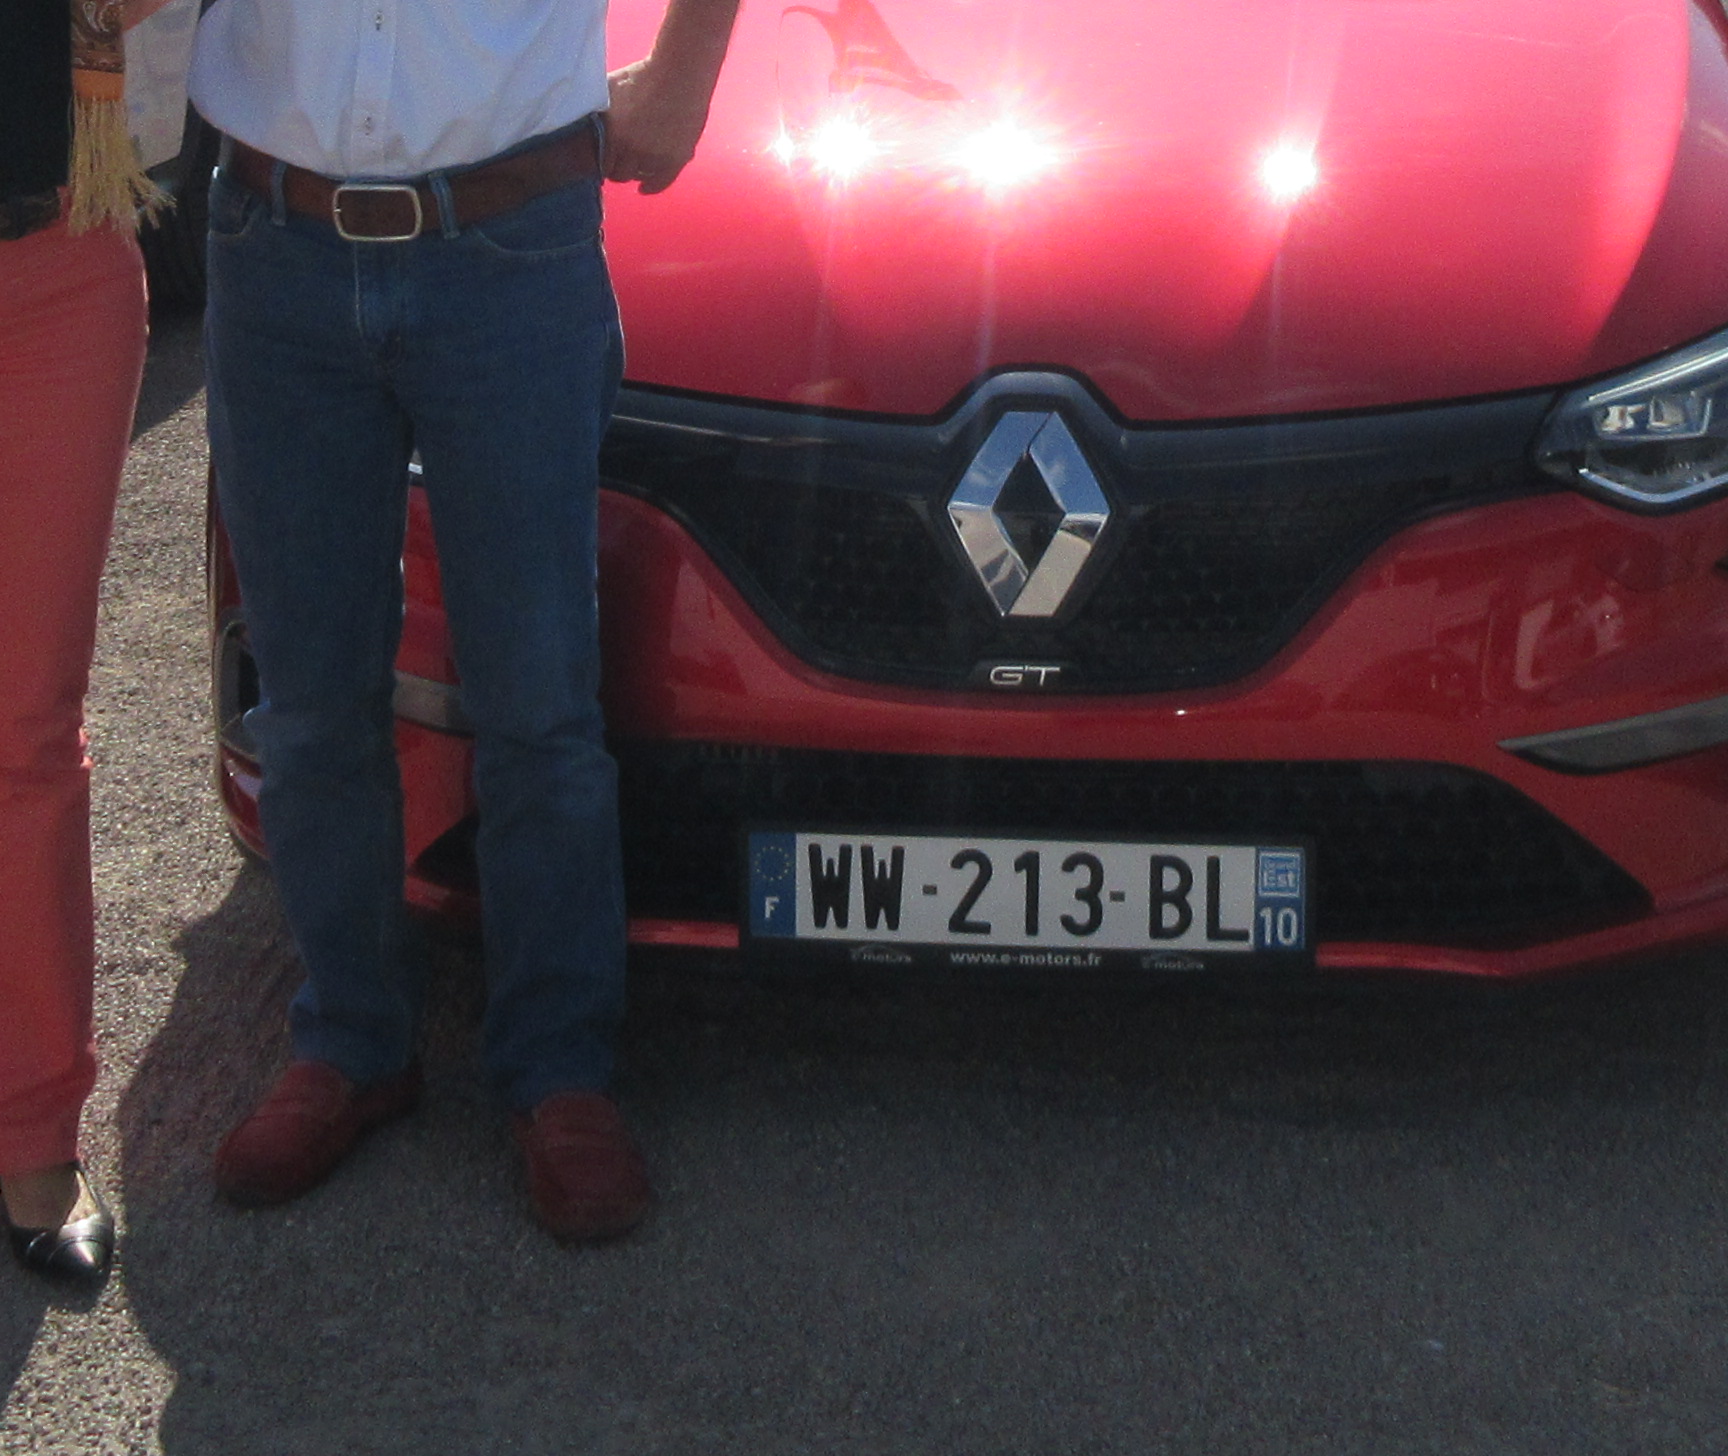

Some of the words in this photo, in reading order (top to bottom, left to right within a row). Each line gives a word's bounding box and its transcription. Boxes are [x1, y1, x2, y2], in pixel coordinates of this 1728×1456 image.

[989, 664, 1060, 686] GT
[808, 843, 1250, 943] WW-213-BL
[765, 896, 780, 919] F
[1259, 906, 1298, 947] 10
[950, 951, 1101, 968] www.e-motors.fr
